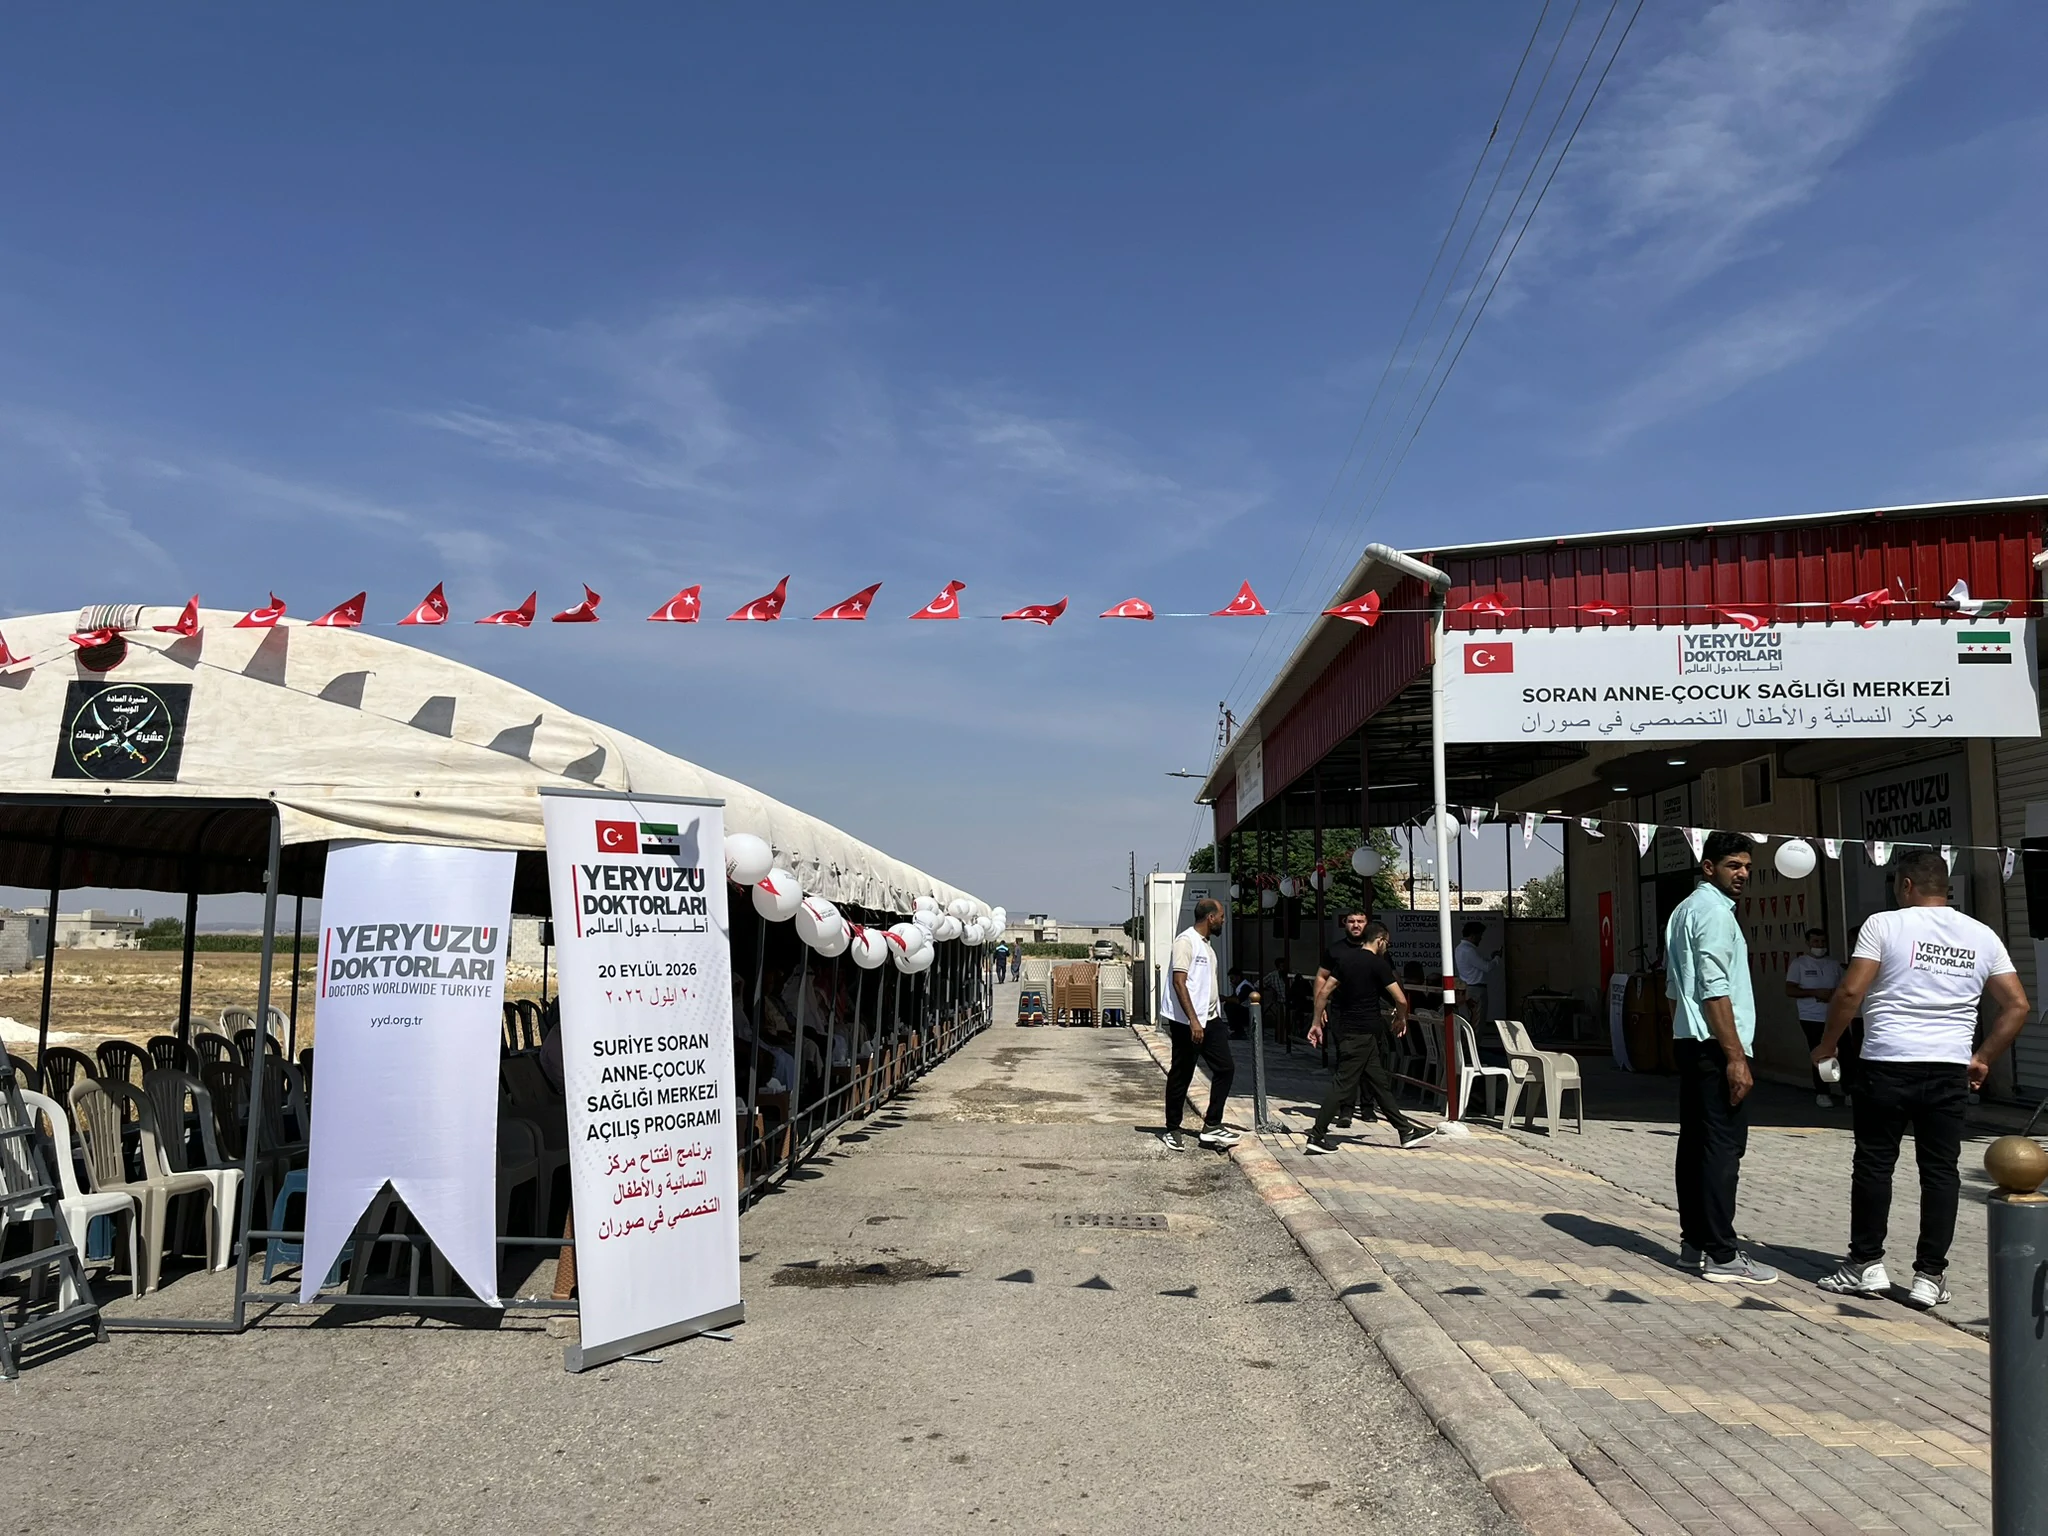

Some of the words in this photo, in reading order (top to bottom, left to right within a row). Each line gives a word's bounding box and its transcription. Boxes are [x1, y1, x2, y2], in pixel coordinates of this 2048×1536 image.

[1684, 649, 1782, 663] DOKTORLARI
[1685, 663, 1712, 675] العالم
[1714, 663, 1733, 675] حول
[1522, 687, 1597, 703] SORAN
[1603, 684, 1751, 704] ANNE-ÇOCUK
[1757, 679, 1845, 699] SAĞLIĞI
[1852, 677, 1950, 697] MERKEZİ
[1521, 712, 1591, 733] صوران
[1598, 710, 1623, 735] في
[1630, 708, 1728, 735] التخصصي
[1824, 705, 1892, 728] النسائية
[1902, 706, 1954, 728] مركز
[1866, 806, 1952, 840] DOKTORLARI
[583, 895, 707, 915] DOKTORLARI
[586, 917, 623, 937] العالم
[626, 918, 649, 937] حول
[652, 917, 709, 937] أطباء
[330, 955, 495, 981] DOKTORLARI
[598, 965, 616, 978] 20
[620, 961, 662, 977] EYLÜL
[666, 963, 697, 976] 2026
[1915, 953, 1975, 970] DOKTORLARI
[329, 983, 369, 997] DOCTORS
[373, 982, 437, 996] WORLDWIDE
[441, 984, 492, 998] TÜRKİYE
[605, 989, 643, 1004] ٢٠٢٦
[370, 1015, 423, 1027] yyd.org.tr
[593, 1034, 653, 1057] SURİYE
[657, 1033, 709, 1052] SORAN
[601, 1059, 706, 1083] ANNE-ÇOCUK
[587, 1087, 653, 1112] SAĞLIĞI
[657, 1080, 718, 1105] MERKEZİ
[586, 1118, 640, 1143] AÇILIŞ
[645, 1108, 721, 1133] PROGRAMI
[604, 1153, 636, 1175] مركز
[640, 1144, 673, 1173] افتتاح
[676, 1142, 712, 1167] برنامج
[613, 1176, 663, 1205] والأطفال
[648, 1205, 664, 1234] في
[667, 1197, 720, 1229] التخصصي
[598, 1217, 645, 1240] صوران
